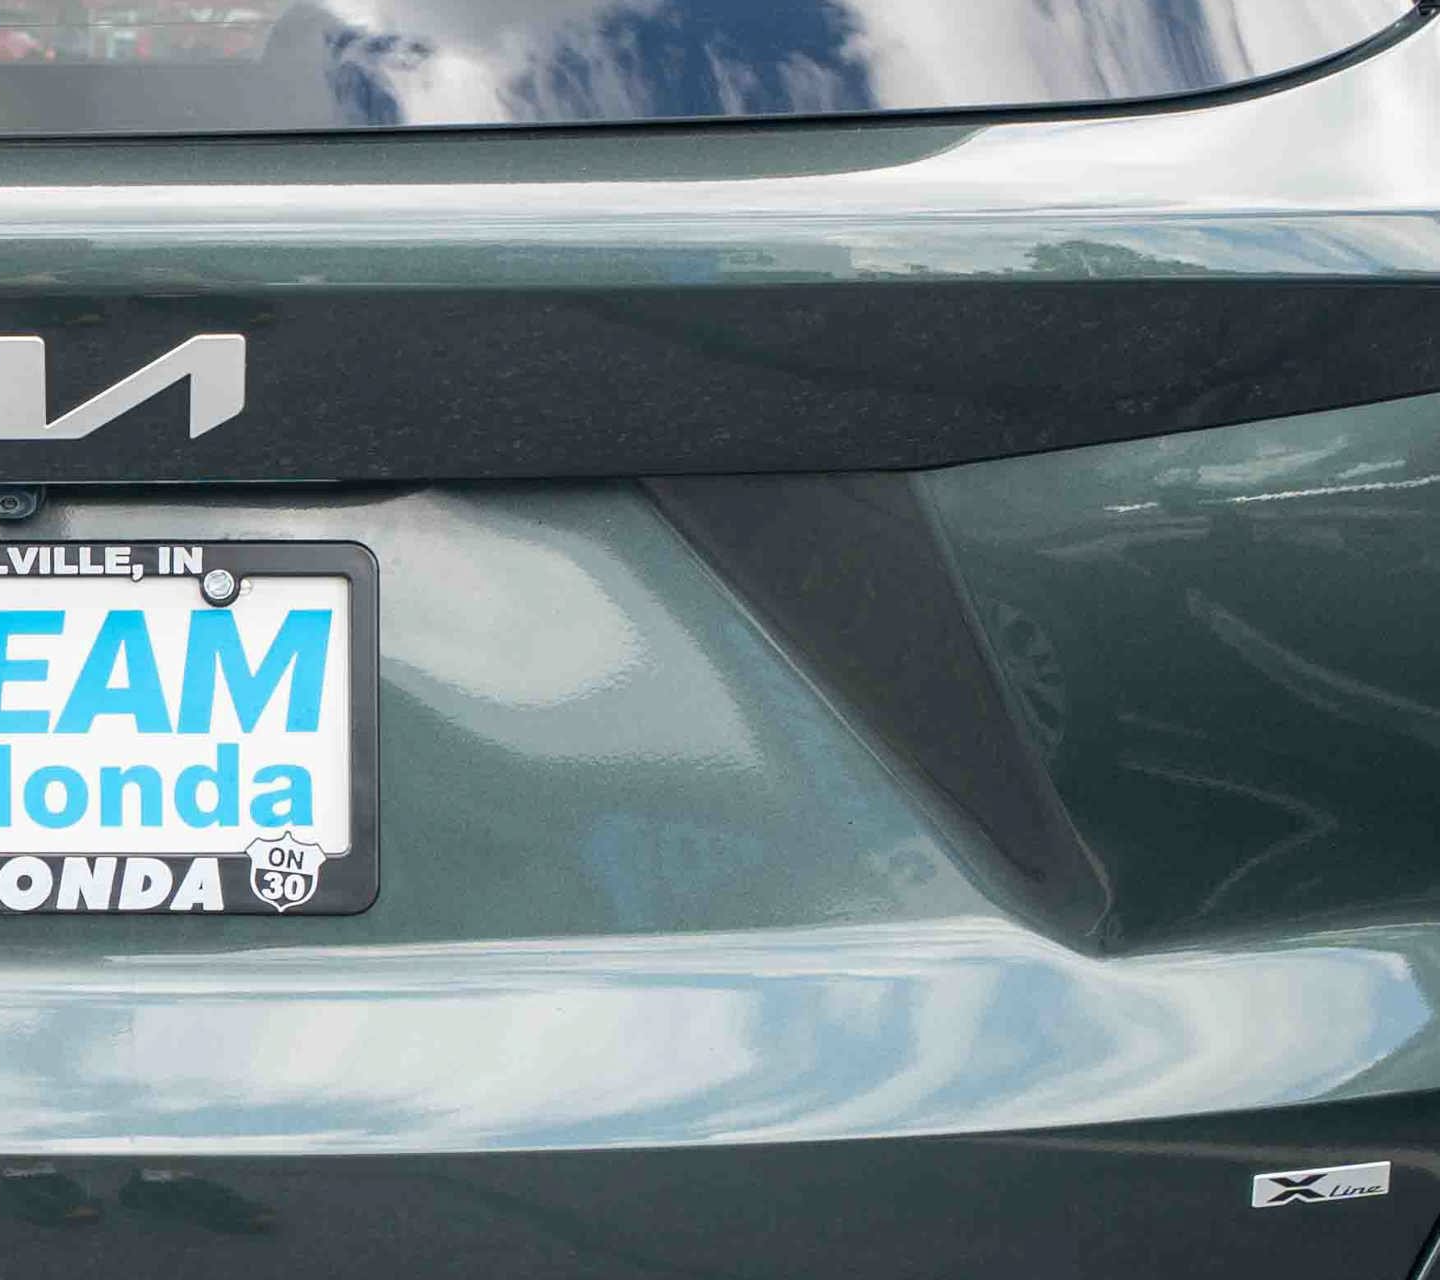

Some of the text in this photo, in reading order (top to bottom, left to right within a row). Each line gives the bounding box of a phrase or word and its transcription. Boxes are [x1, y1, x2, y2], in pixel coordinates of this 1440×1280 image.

[159, 547, 203, 575] IN
[268, 847, 304, 870] ON
[261, 871, 305, 901] 30
